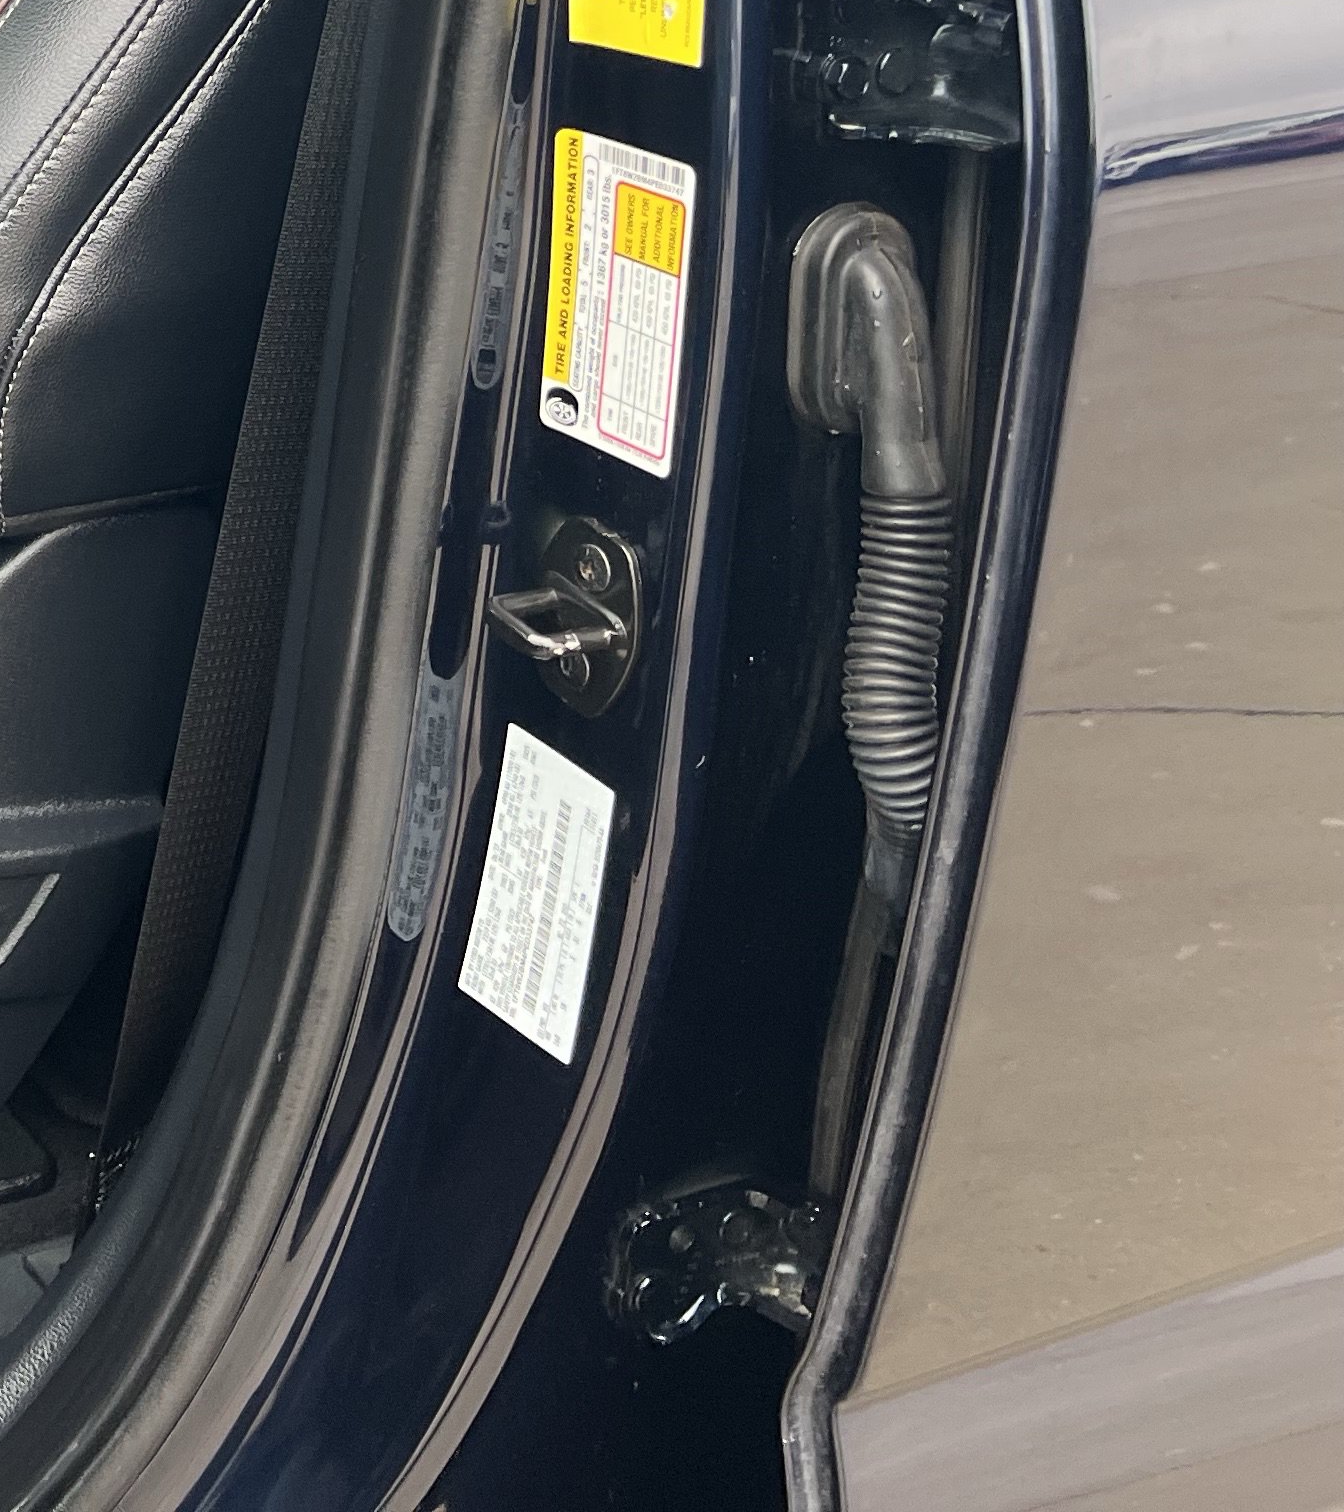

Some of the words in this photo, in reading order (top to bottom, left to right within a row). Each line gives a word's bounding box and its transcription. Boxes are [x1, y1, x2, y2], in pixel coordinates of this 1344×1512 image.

[563, 135, 579, 238] INFORMATION
[586, 166, 594, 177] 3
[599, 193, 611, 225] 3015
[625, 191, 636, 236] OWNERS
[641, 196, 650, 218] FOR
[583, 222, 591, 232] 2
[600, 225, 609, 240] or
[637, 217, 649, 261] MANUAL
[651, 202, 665, 264] ADDITIONAL
[666, 202, 680, 272] INFORMATION
[597, 239, 609, 257] kg
[623, 236, 633, 256] SEE
[560, 239, 573, 306] LOADING
[580, 277, 588, 288] 5
[595, 256, 607, 287] 1367
[557, 307, 569, 339] AND
[553, 340, 566, 377] TIRE
